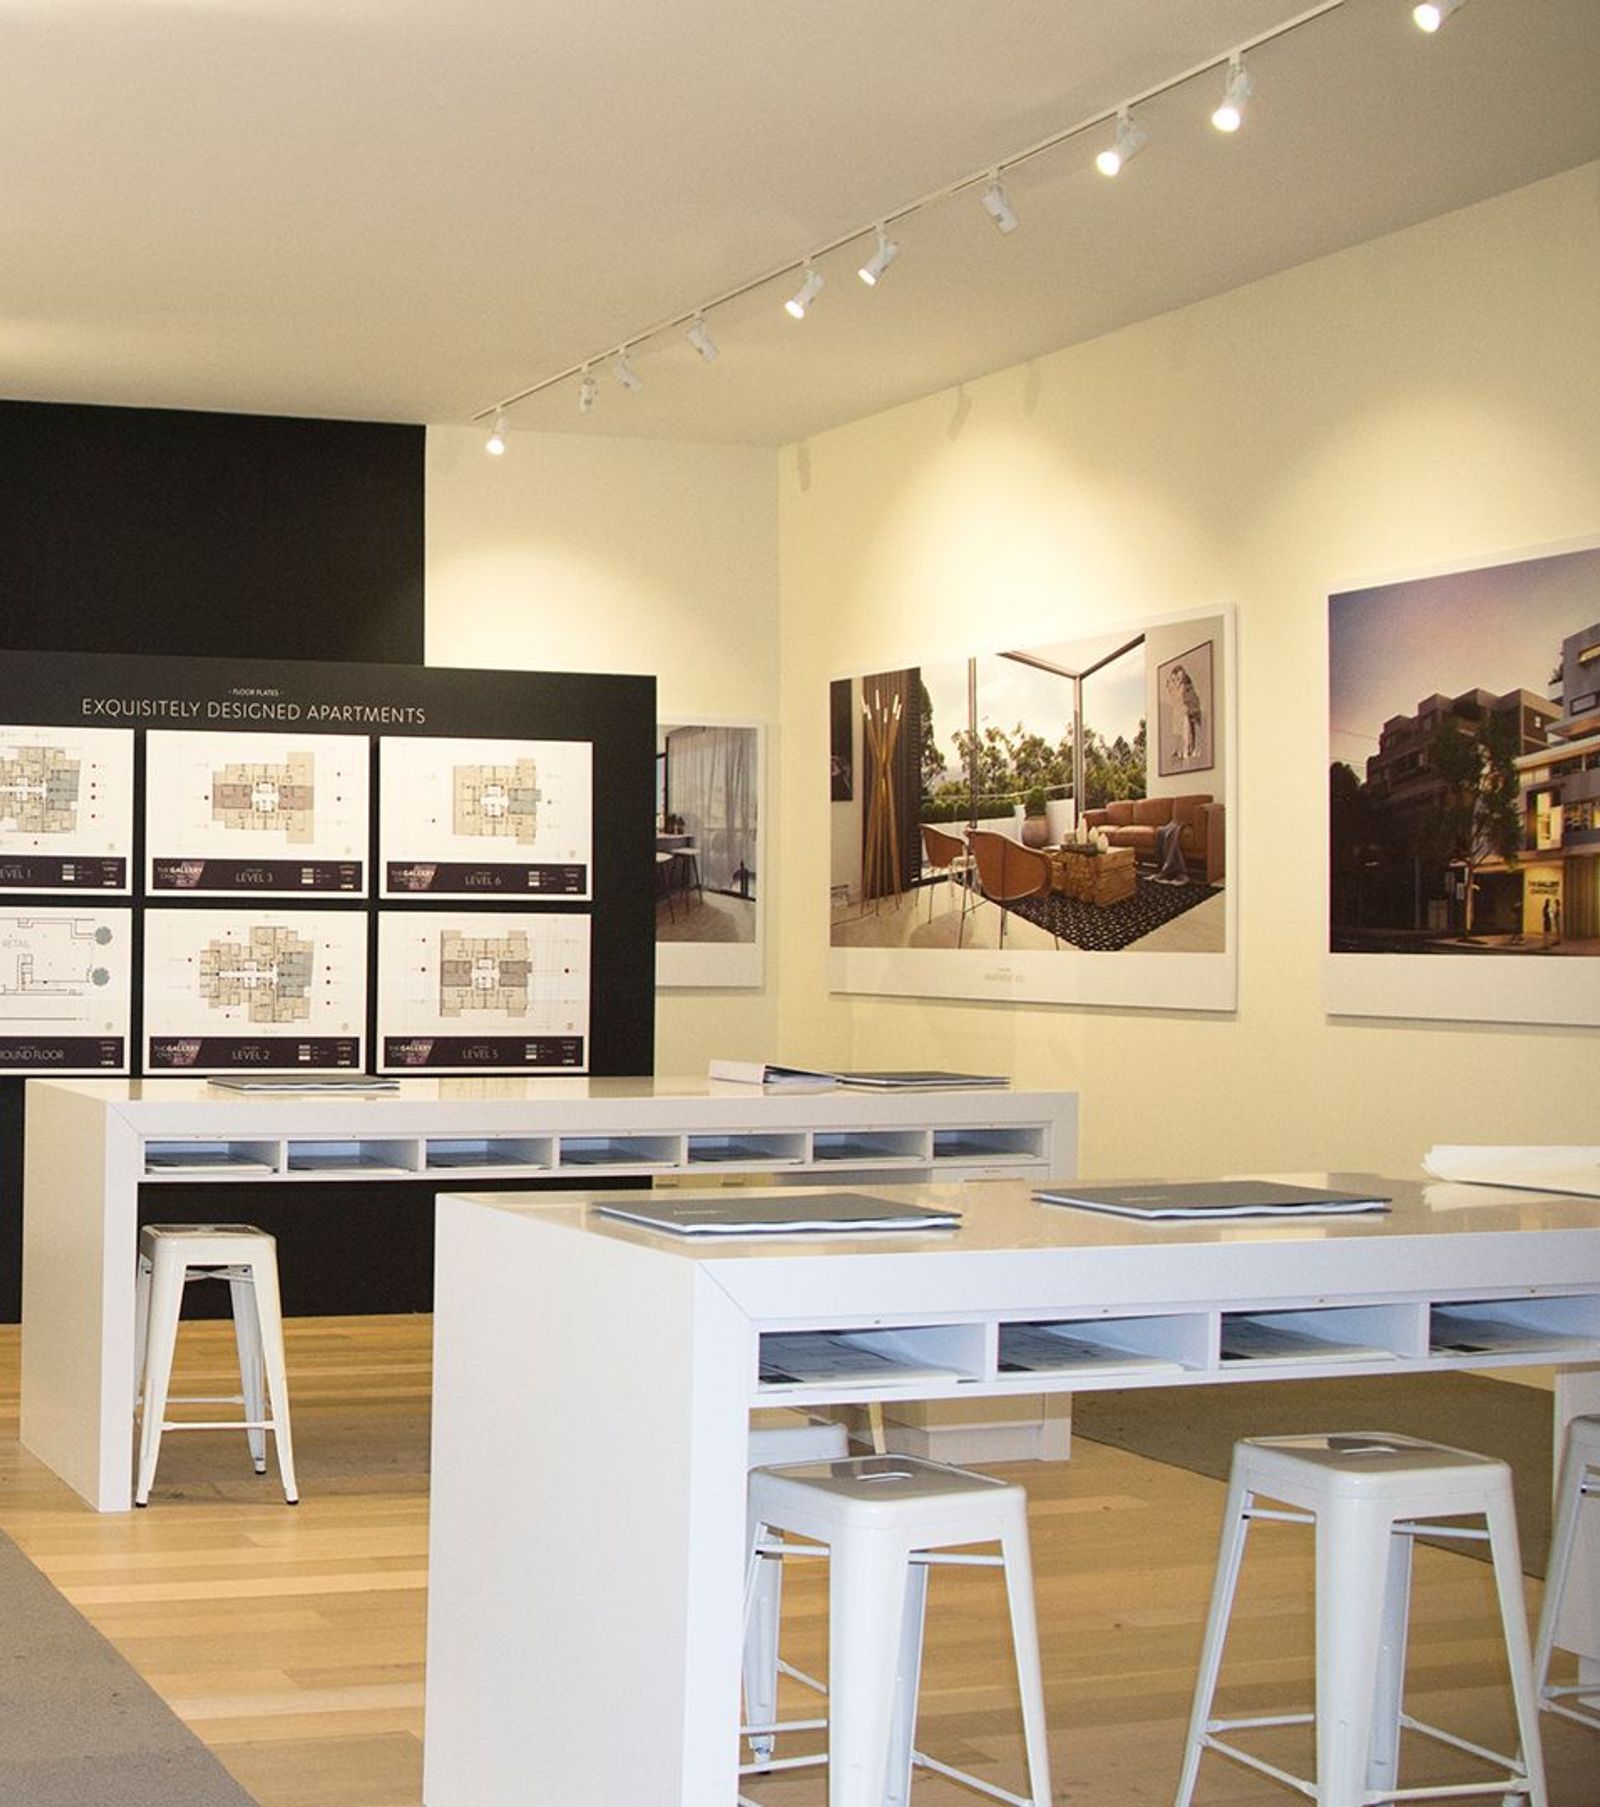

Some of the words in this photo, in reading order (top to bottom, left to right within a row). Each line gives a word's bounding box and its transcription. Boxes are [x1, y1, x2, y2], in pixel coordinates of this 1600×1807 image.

[81, 697, 200, 717] EXQUISITELY
[207, 701, 301, 721] DESIGNED
[307, 704, 426, 724] APARTMENTS
[235, 873, 266, 883] LEVEL
[267, 874, 274, 883] 3
[464, 875, 492, 885] LEVEL
[33, 1050, 65, 1060] FLOOR
[232, 1050, 262, 1060] LEVEL
[263, 1051, 270, 1060] 2
[462, 1049, 491, 1059] LEVEL
